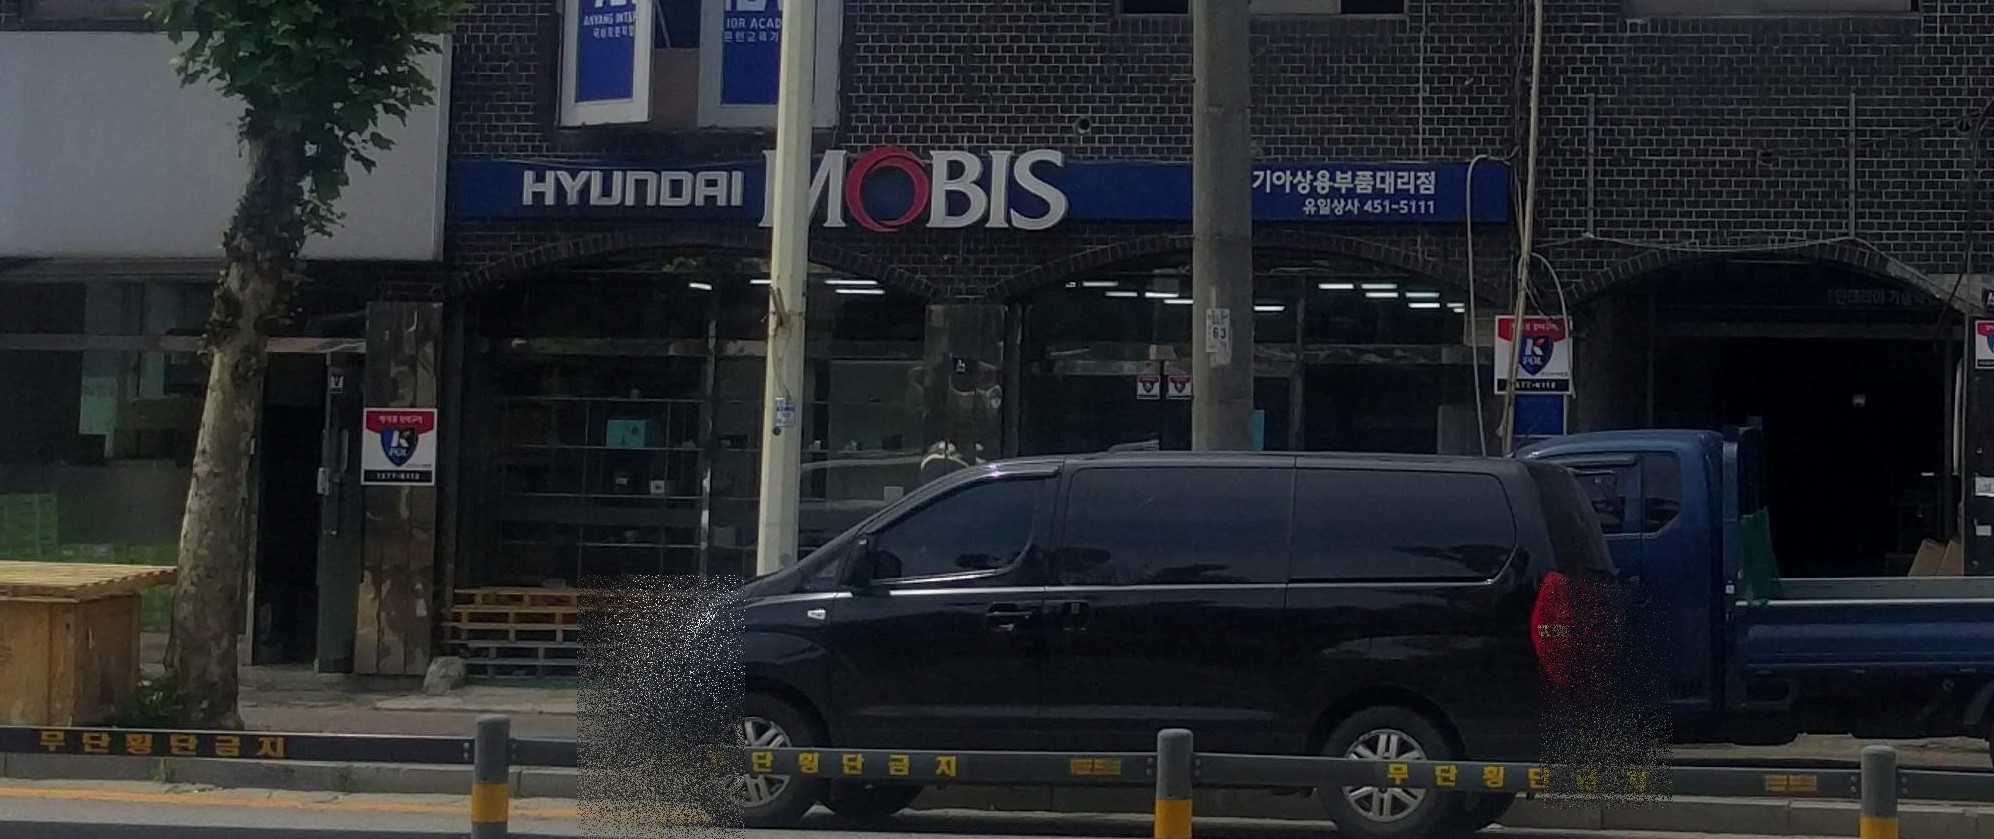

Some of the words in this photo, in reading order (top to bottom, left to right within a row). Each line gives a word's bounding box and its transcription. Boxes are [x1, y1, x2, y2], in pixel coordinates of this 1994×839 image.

[522, 169, 743, 207] HYUNDAI
[759, 146, 1070, 233] MOBIS
[1302, 197, 1360, 215] 유일상사
[1363, 199, 1436, 215] 451-5111
